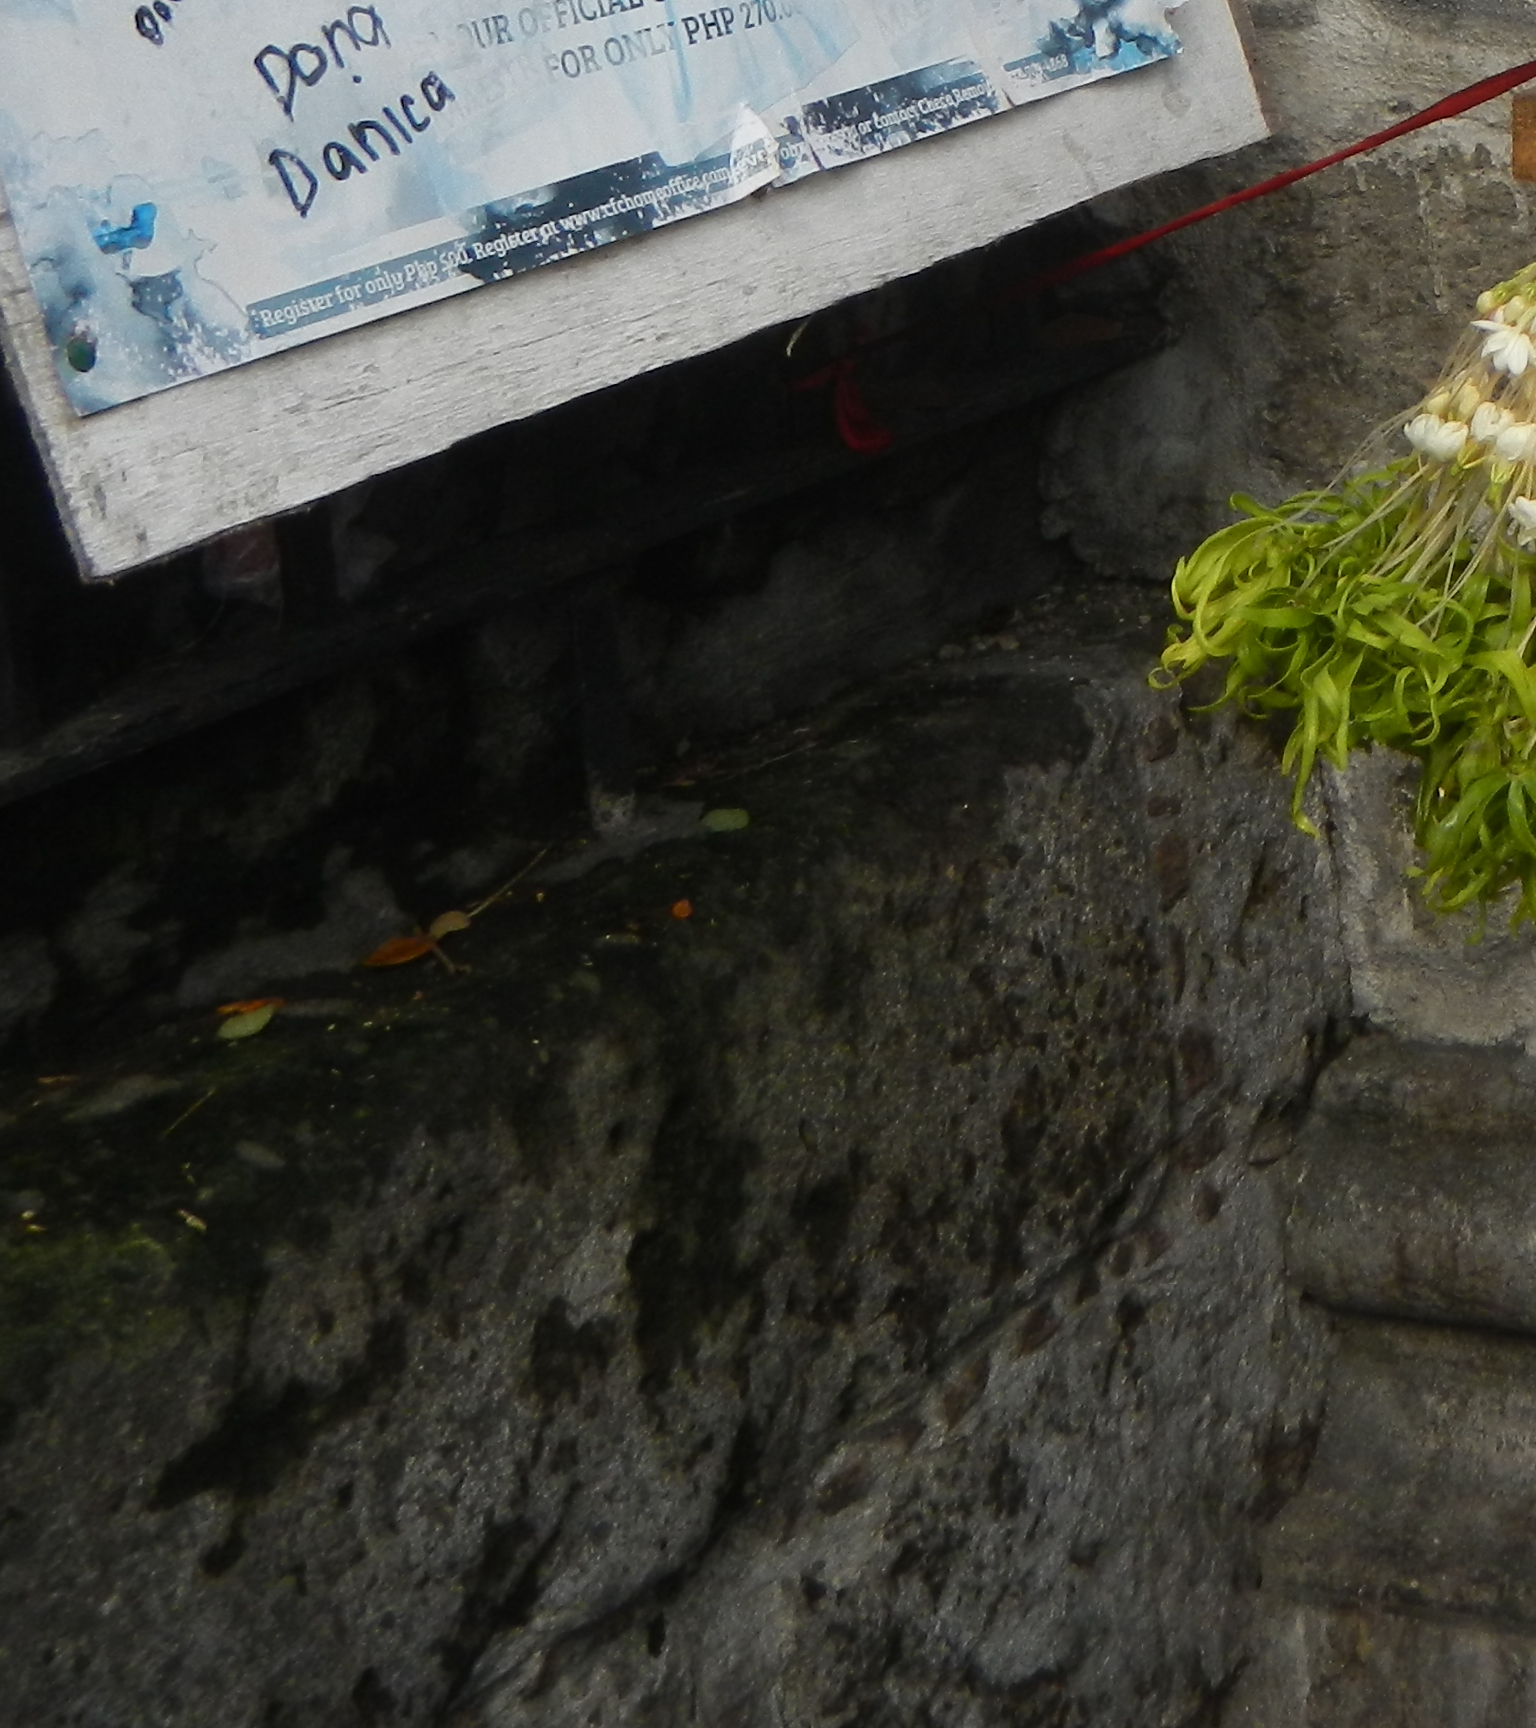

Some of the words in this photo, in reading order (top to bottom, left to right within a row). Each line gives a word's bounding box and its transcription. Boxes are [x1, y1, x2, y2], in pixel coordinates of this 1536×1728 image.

[682, 6, 735, 46] PHP
[260, 288, 334, 328] Register
[335, 280, 363, 307] for
[472, 227, 538, 261] Register
